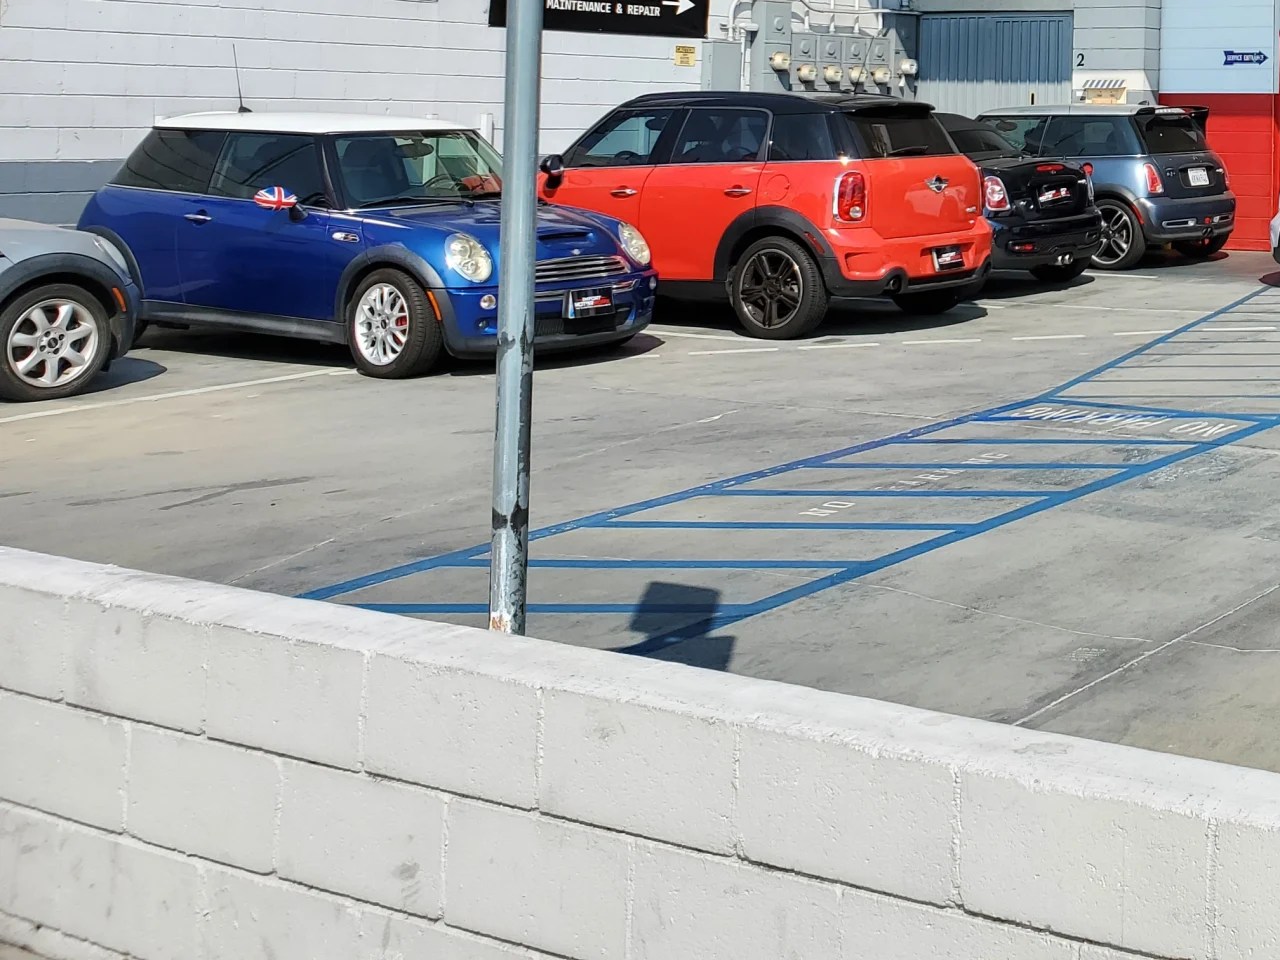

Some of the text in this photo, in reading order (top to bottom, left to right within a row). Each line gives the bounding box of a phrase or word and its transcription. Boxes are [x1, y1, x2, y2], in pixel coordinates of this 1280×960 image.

[546, 0, 661, 17] MAINTENANCE & REPAIR
[1076, 53, 1085, 67] 2
[1169, 421, 1238, 437] NO
[798, 500, 855, 517] NO
